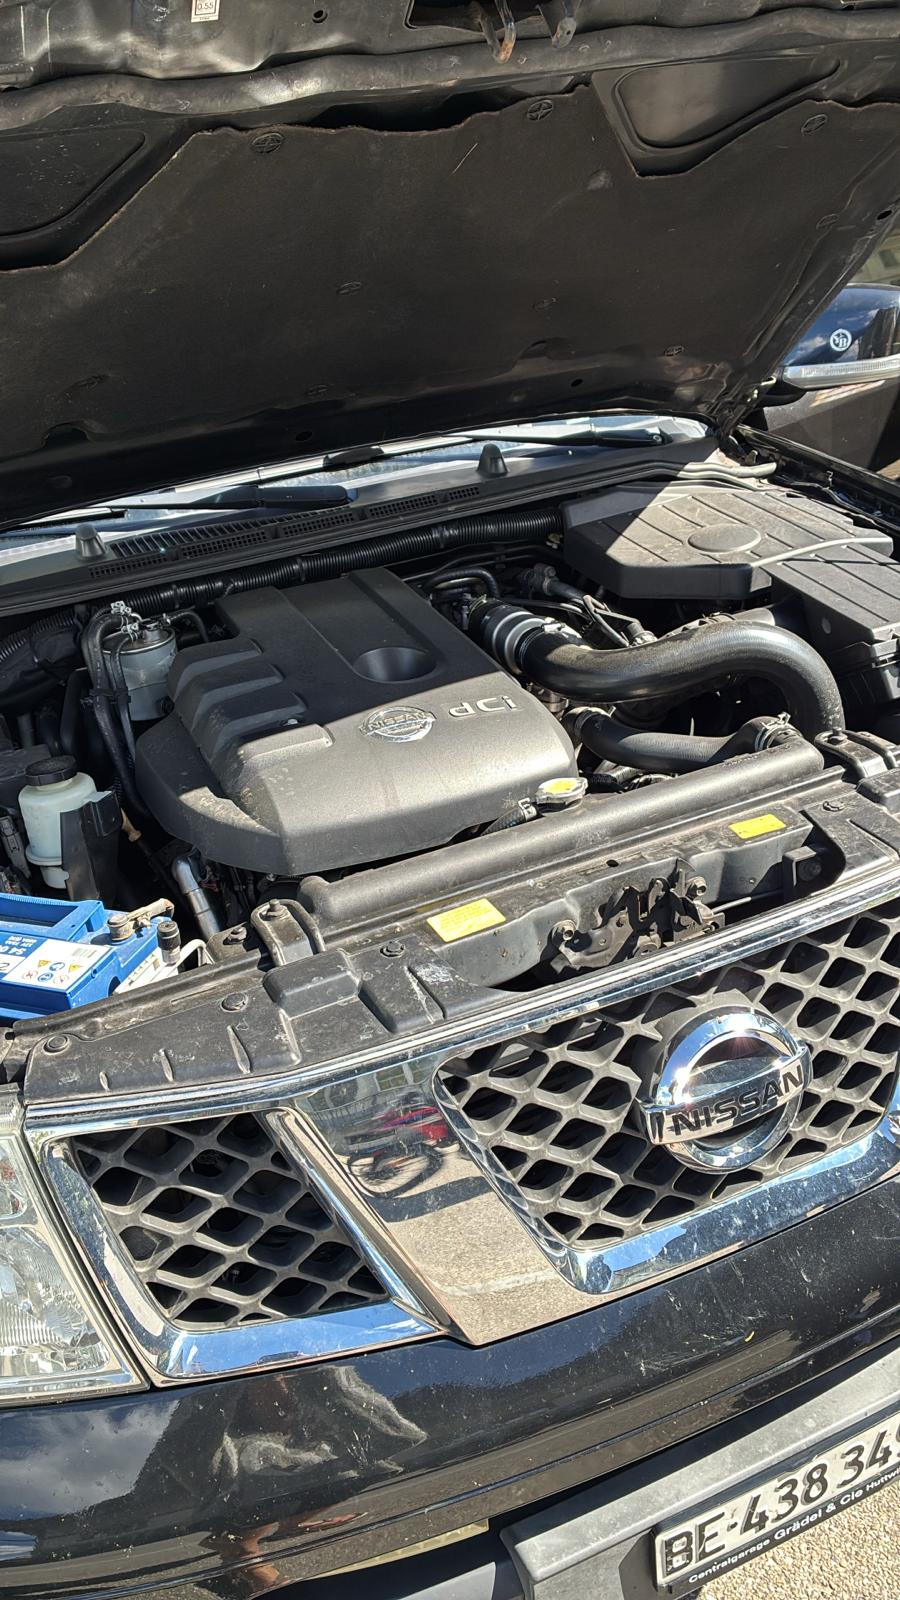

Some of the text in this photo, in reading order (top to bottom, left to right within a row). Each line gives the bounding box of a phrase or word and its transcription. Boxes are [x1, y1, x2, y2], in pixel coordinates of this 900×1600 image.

[368, 712, 428, 731] NISSAN
[449, 696, 517, 717] dCi
[671, 1065, 803, 1136] NISSAN
[837, 1424, 900, 1488] 34
[688, 1539, 770, 1583] Centralgarage
[774, 1509, 822, 1540] Grädel
[825, 1503, 837, 1513] &
[866, 1466, 900, 1491] Huttwi
